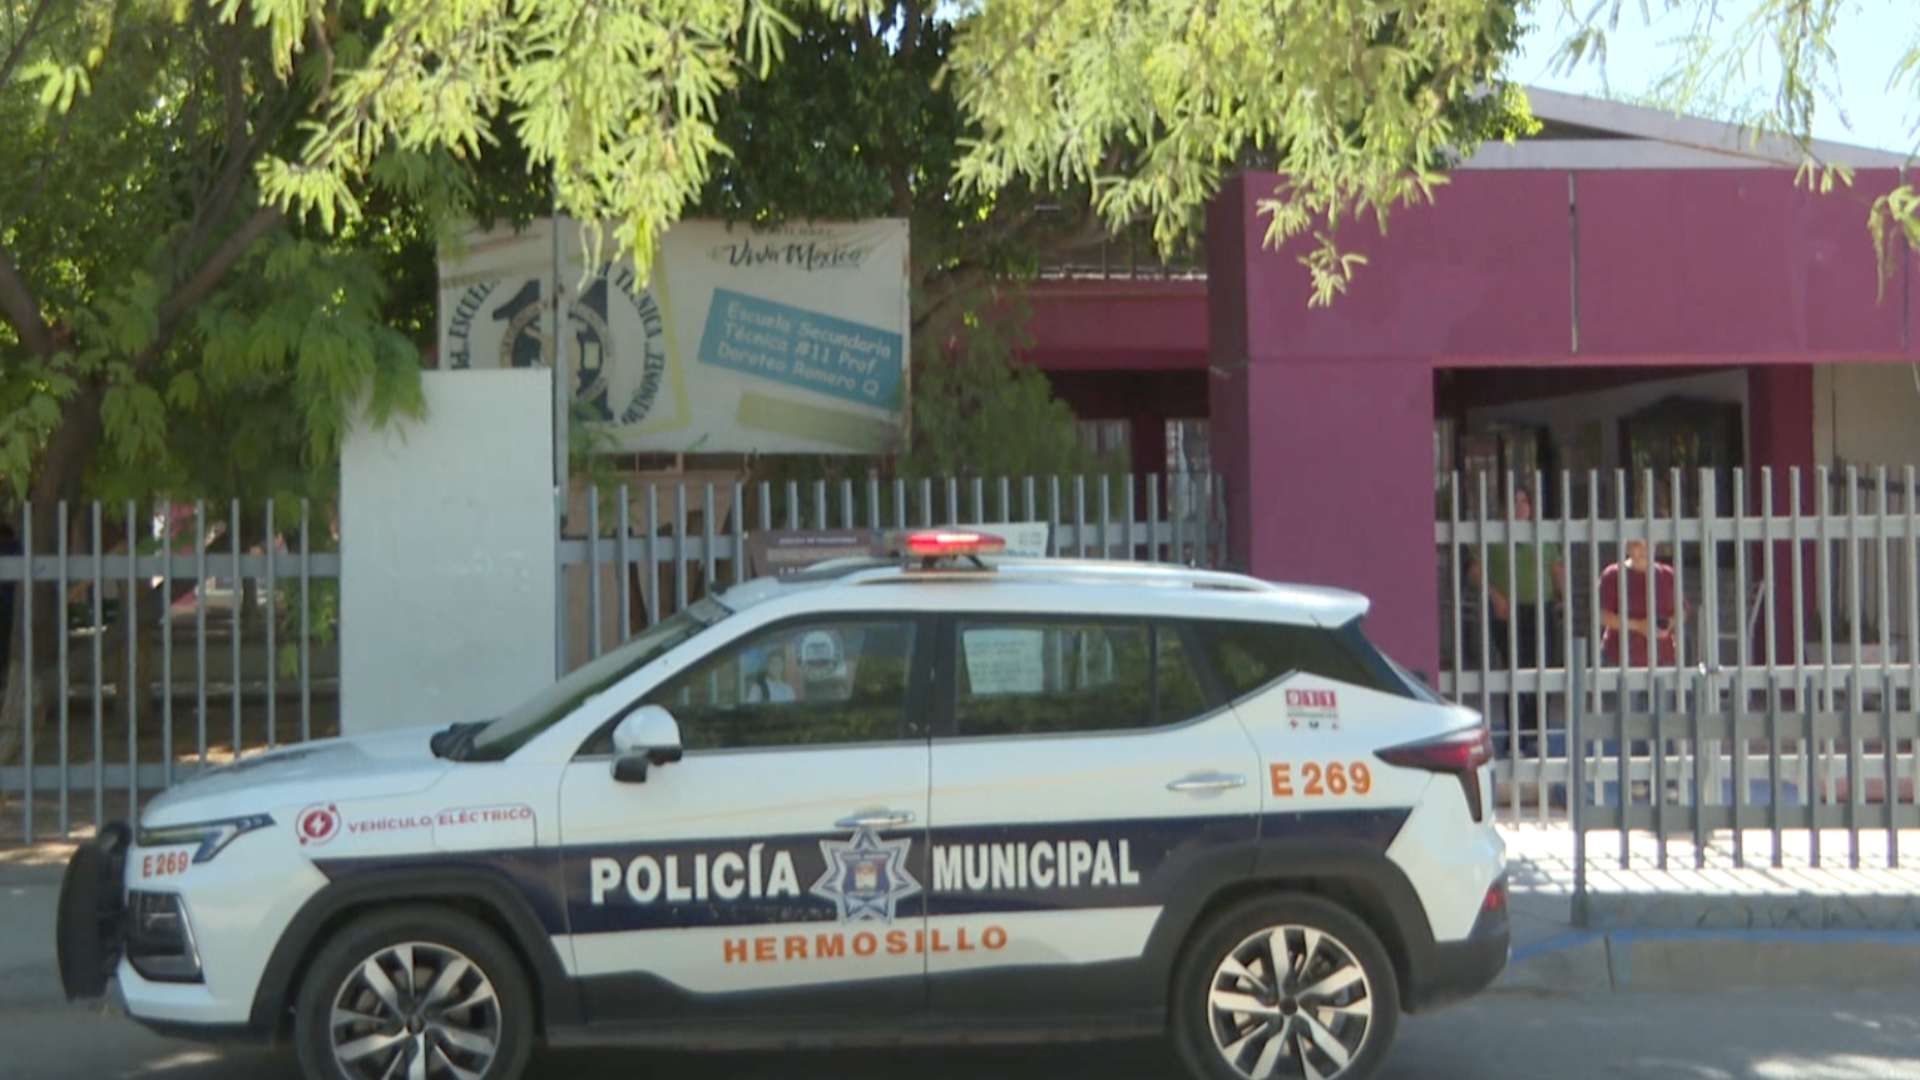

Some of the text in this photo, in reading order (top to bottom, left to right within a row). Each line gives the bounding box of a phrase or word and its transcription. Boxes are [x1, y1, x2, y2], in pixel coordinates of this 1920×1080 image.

[727, 301, 891, 359] Escuela Secundaria
[718, 341, 787, 372] Doroteo
[792, 360, 856, 391] Romero
[1270, 761, 1371, 796] E 269
[348, 807, 532, 833] VEHÍCULO ELÉCTRICO
[143, 850, 189, 878] E 269
[590, 839, 1140, 905] POLICÍA MUNICIPAL
[723, 926, 1007, 963] HERMOSILLO
